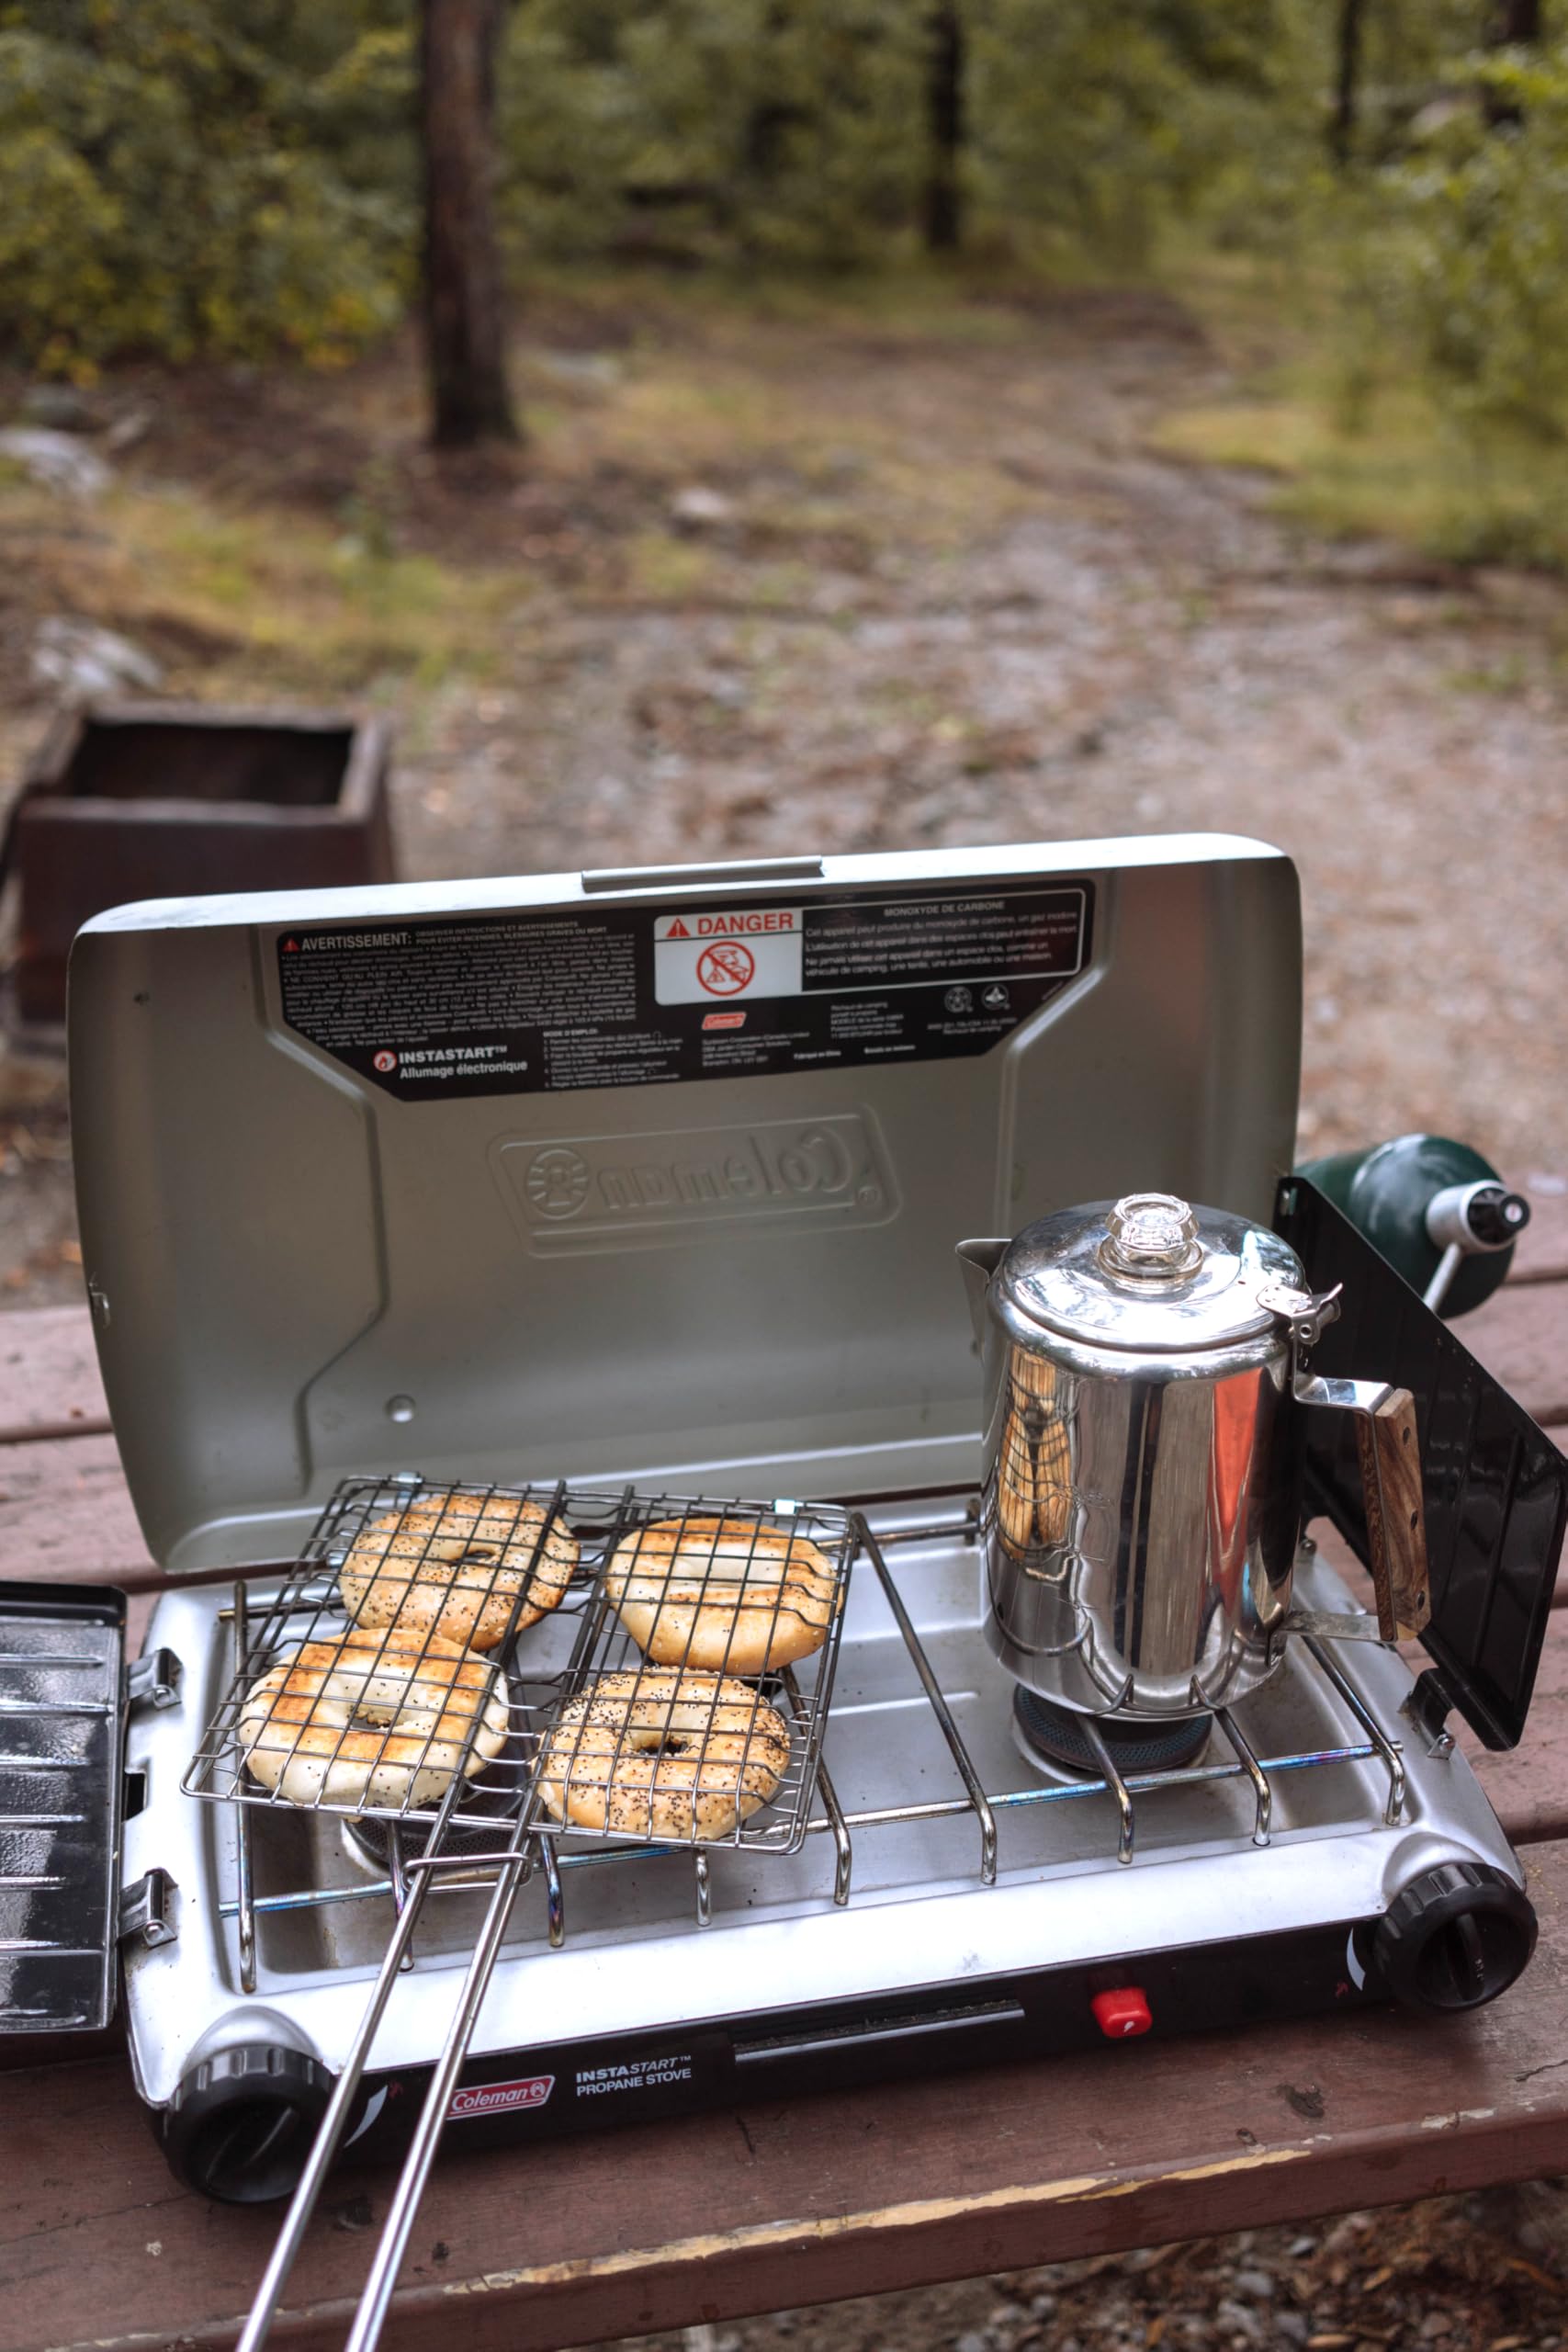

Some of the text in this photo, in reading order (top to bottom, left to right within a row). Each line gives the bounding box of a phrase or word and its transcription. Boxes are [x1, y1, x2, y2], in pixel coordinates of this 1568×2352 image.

[884, 900, 1005, 917] MONOXYDE DE CARBONE
[697, 912, 794, 935] DANGER
[301, 932, 412, 951] AVERTISSEMENT:
[400, 1066, 455, 1080] Allumage
[457, 1060, 528, 1075] électronique
[576, 2067, 692, 2098] PROPANE STOVE
[451, 2086, 529, 2112] Coleman
